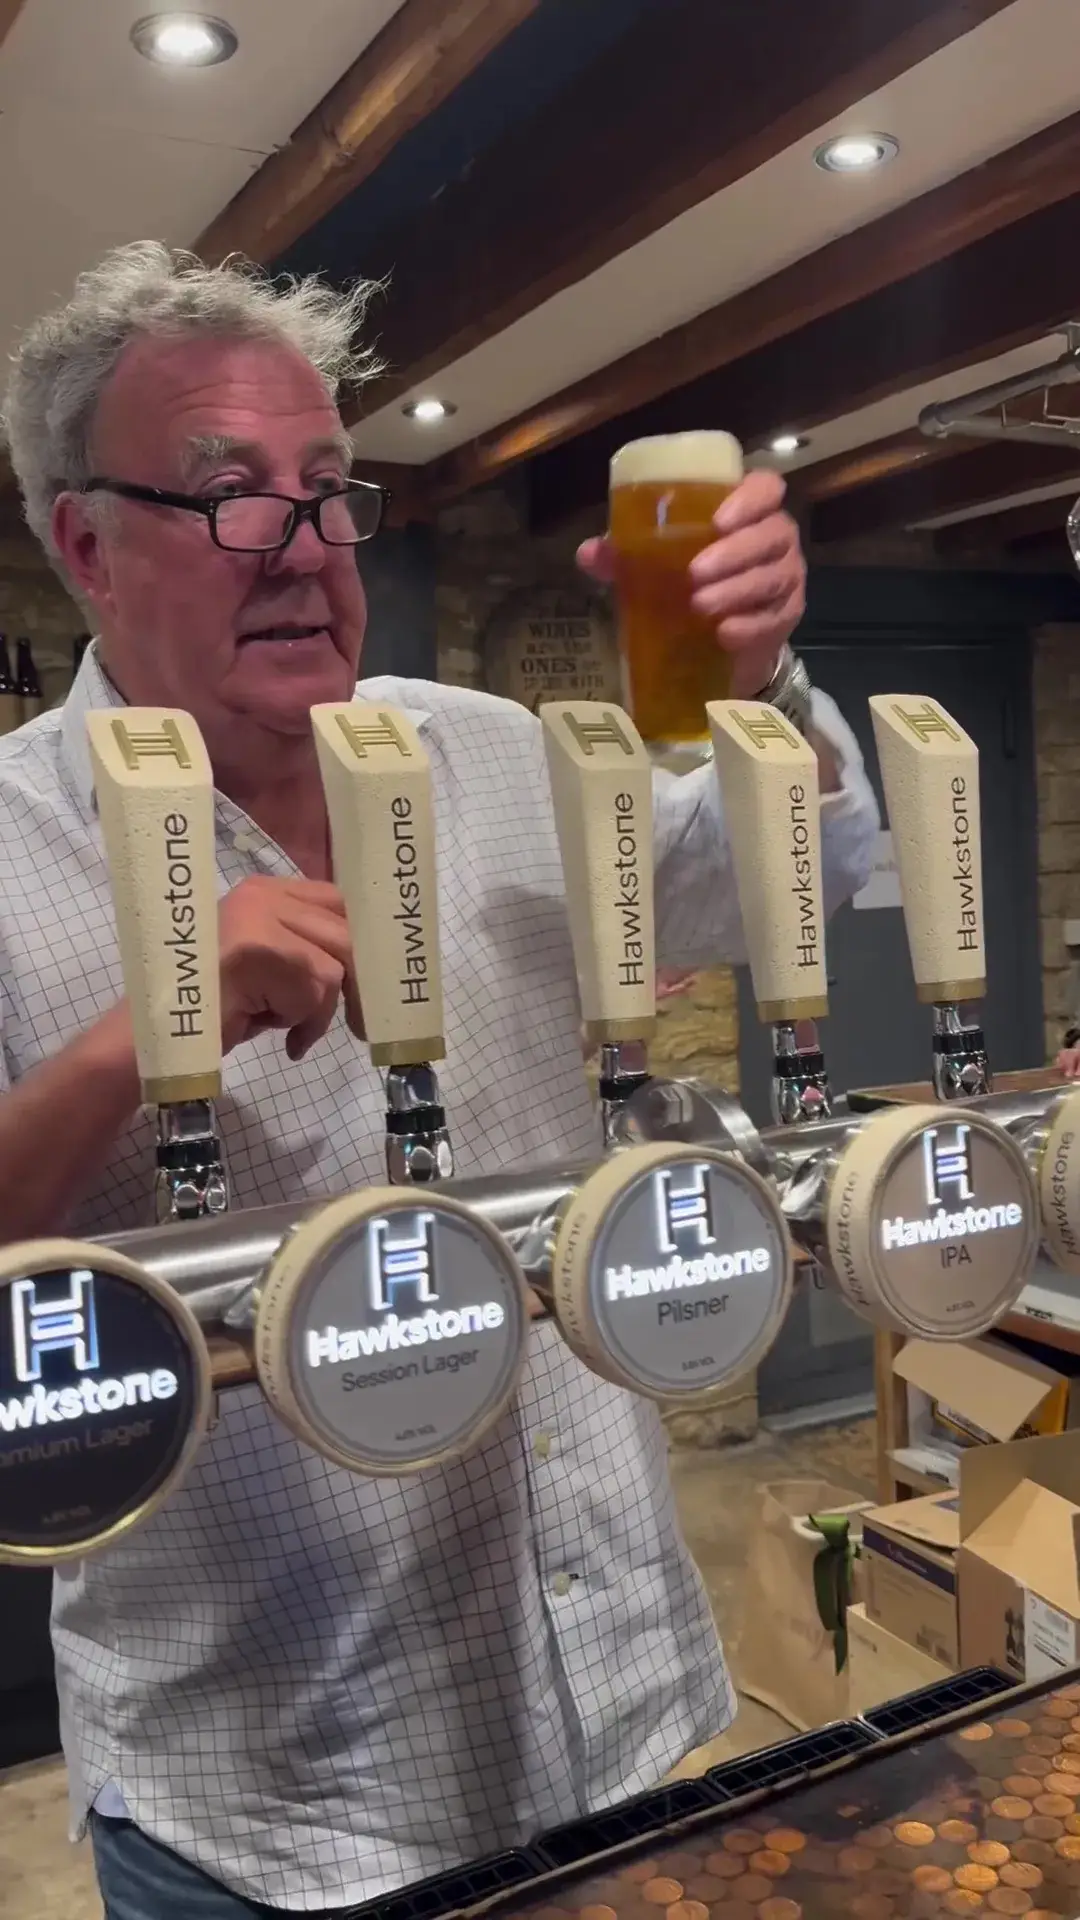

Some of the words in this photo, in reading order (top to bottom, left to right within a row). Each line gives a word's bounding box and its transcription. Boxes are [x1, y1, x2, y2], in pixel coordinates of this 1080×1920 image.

[520, 656, 577, 674] ONES
[614, 792, 645, 986] Hawkstone
[790, 783, 819, 968] Hawkstone
[952, 775, 978, 951] Hawkstone
[163, 813, 203, 1038] Hawkstone
[391, 796, 429, 1004] Hawkstone
[881, 1202, 1023, 1250] Hawkstone
[605, 1247, 771, 1301] Hawkstone
[939, 1244, 973, 1269] IPA
[307, 1301, 505, 1368] Hawkstone
[657, 1294, 730, 1326] Pilsner
[341, 1362, 419, 1392] Session
[422, 1348, 480, 1376] Lager
[85, 1418, 155, 1448] Lager
